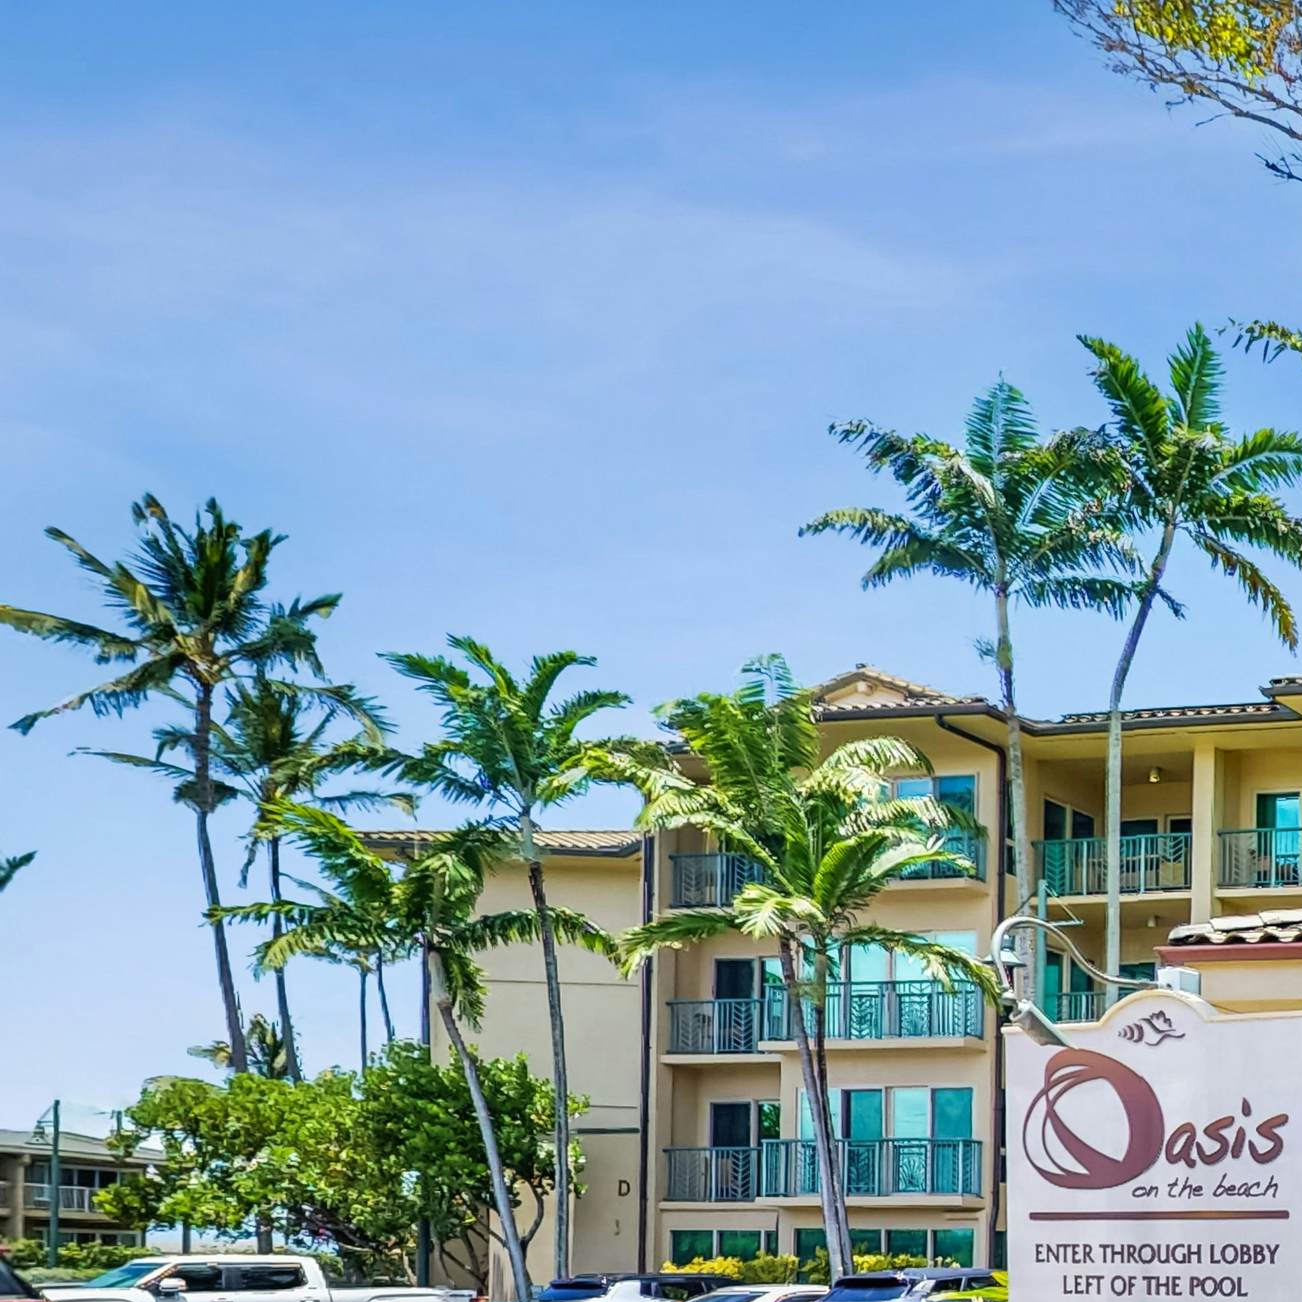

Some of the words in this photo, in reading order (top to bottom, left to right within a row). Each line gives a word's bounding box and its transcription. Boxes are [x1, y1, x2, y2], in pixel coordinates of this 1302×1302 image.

[1023, 1048, 1289, 1190] Oasis
[618, 1180, 631, 1197] D
[1131, 1184, 1159, 1198] on
[1167, 1176, 1204, 1199] the
[1212, 1172, 1279, 1198] beach
[1034, 1243, 1095, 1264] ENTER
[1099, 1243, 1202, 1265] THROUGH
[1209, 1243, 1281, 1265] LOBBY
[1062, 1275, 1104, 1295] LEFT
[1110, 1275, 1137, 1297] OF
[1142, 1276, 1183, 1296] THE
[1189, 1276, 1249, 1297] POOL
